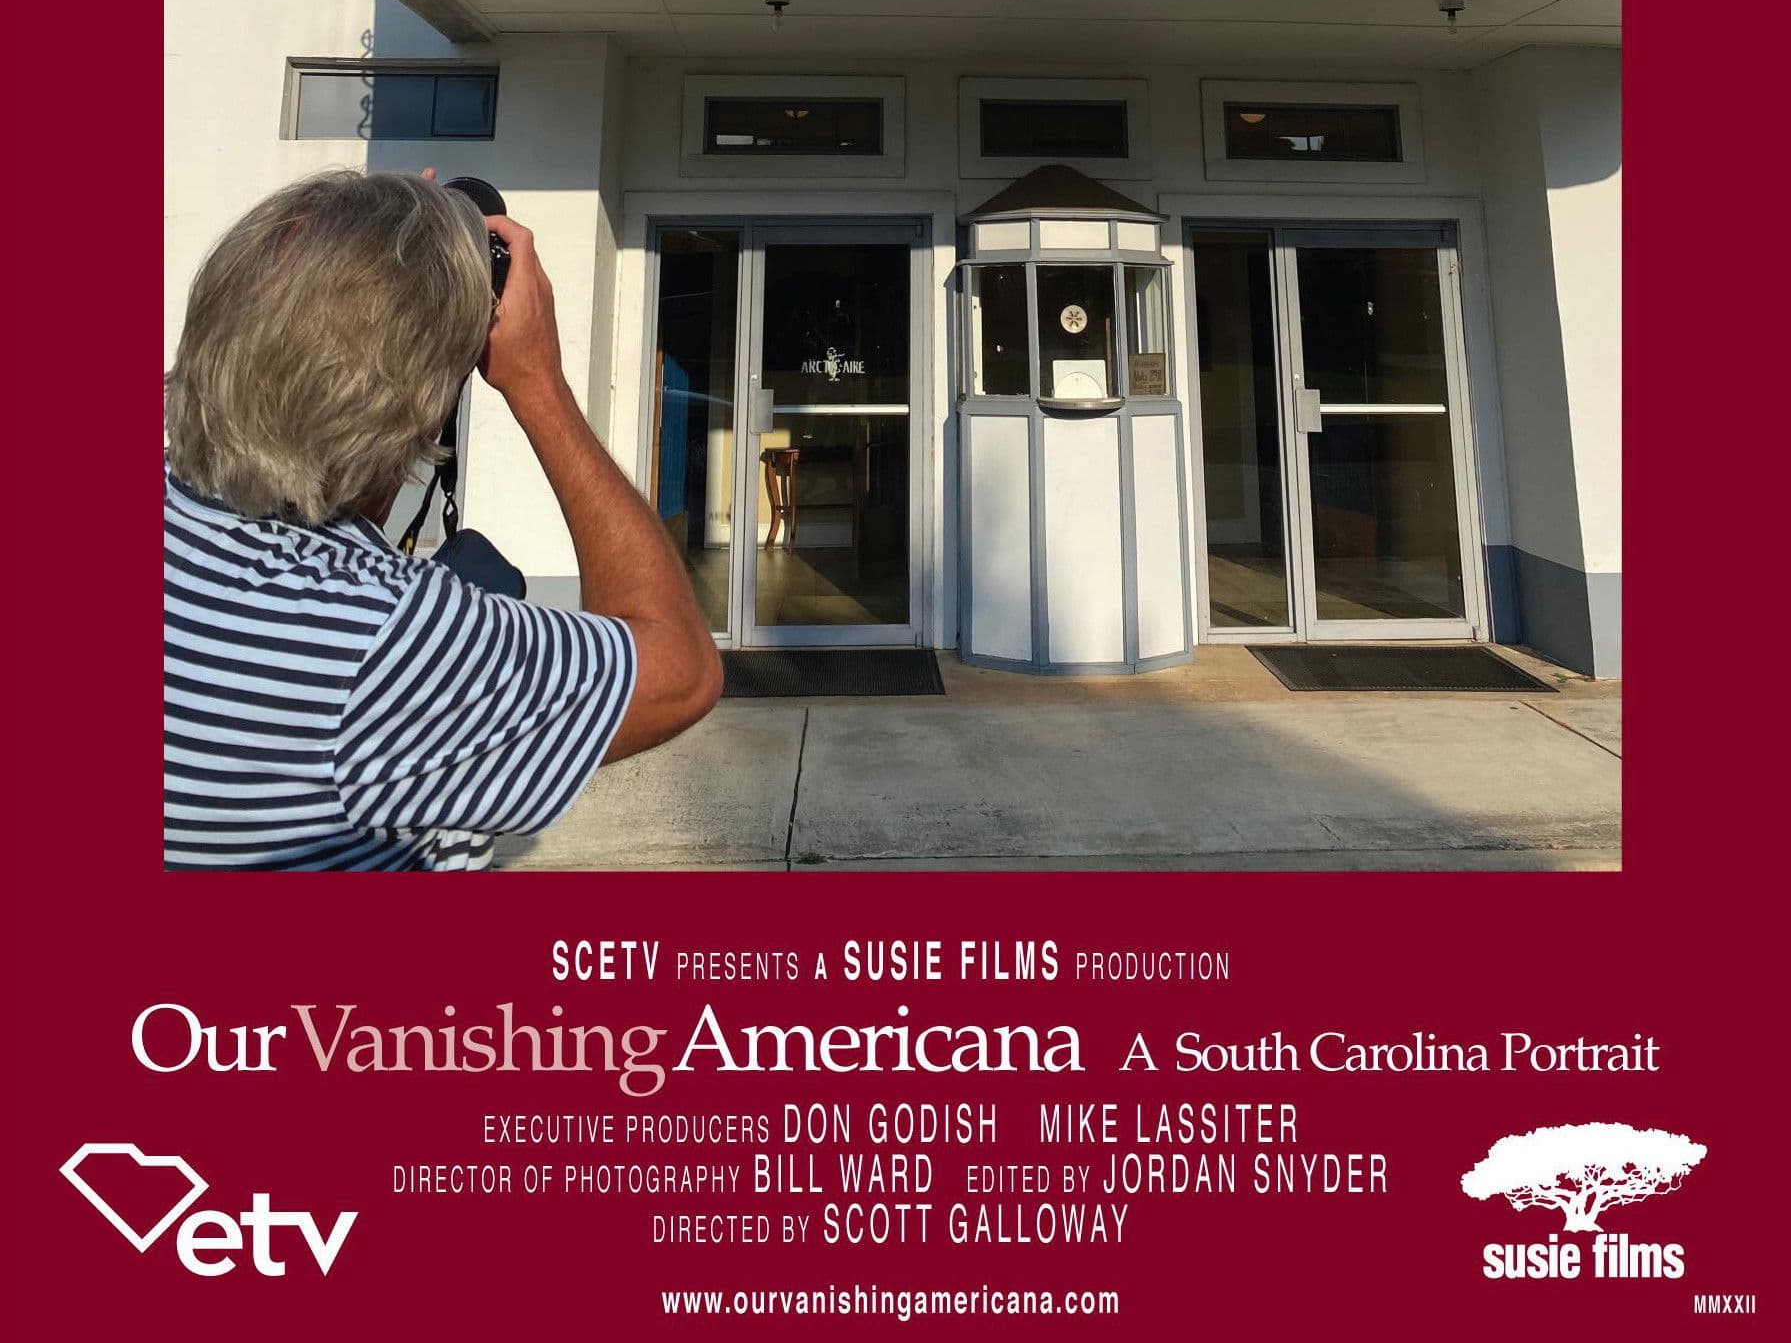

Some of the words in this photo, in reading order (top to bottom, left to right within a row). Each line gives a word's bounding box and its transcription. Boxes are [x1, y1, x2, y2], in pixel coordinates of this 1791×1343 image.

[553, 940, 659, 980] SCETV
[678, 952, 798, 980] PRESENTS
[815, 953, 827, 979] A
[844, 940, 941, 980] SUSIE
[961, 940, 1058, 980] FILMS
[1077, 952, 1228, 980] PRODUCTION
[132, 1004, 286, 1072] Our
[291, 1003, 667, 1096] Vanishing
[672, 1004, 1085, 1072] Americana
[1119, 1033, 1158, 1070] A
[1176, 1032, 1300, 1071] South
[1310, 1032, 1490, 1071] Carolina
[1501, 1032, 1660, 1071] Portrait
[485, 1115, 613, 1143] EXECUTIVE
[627, 1115, 768, 1143] PRODUCERS
[785, 1103, 849, 1143] DON
[869, 1103, 995, 1143] GODISH
[1041, 1104, 1117, 1142] MIKE
[1137, 1103, 1296, 1143] LASSITER
[394, 1165, 511, 1193] DIRECTOR
[524, 1165, 552, 1193] OF
[566, 1165, 739, 1193] PHOTOGRAPHY
[755, 1154, 822, 1192] BILL
[840, 1154, 932, 1192] WARD
[968, 1165, 1049, 1193] EDITED
[1064, 1165, 1089, 1193] BY
[1103, 1153, 1234, 1193] JORDAN
[1254, 1153, 1386, 1193] SNYDER
[177, 1193, 358, 1276] etv
[654, 1215, 769, 1243] DIRECTED
[783, 1216, 809, 1243] BY
[824, 1203, 932, 1243] SCOTT
[950, 1203, 1128, 1243] GALLOWAY
[1483, 1234, 1580, 1278] susie
[1592, 1233, 1685, 1278] films
[662, 1285, 1118, 1321] www.ourvanishingamericana.com
[1694, 1294, 1756, 1314] MMXXII
